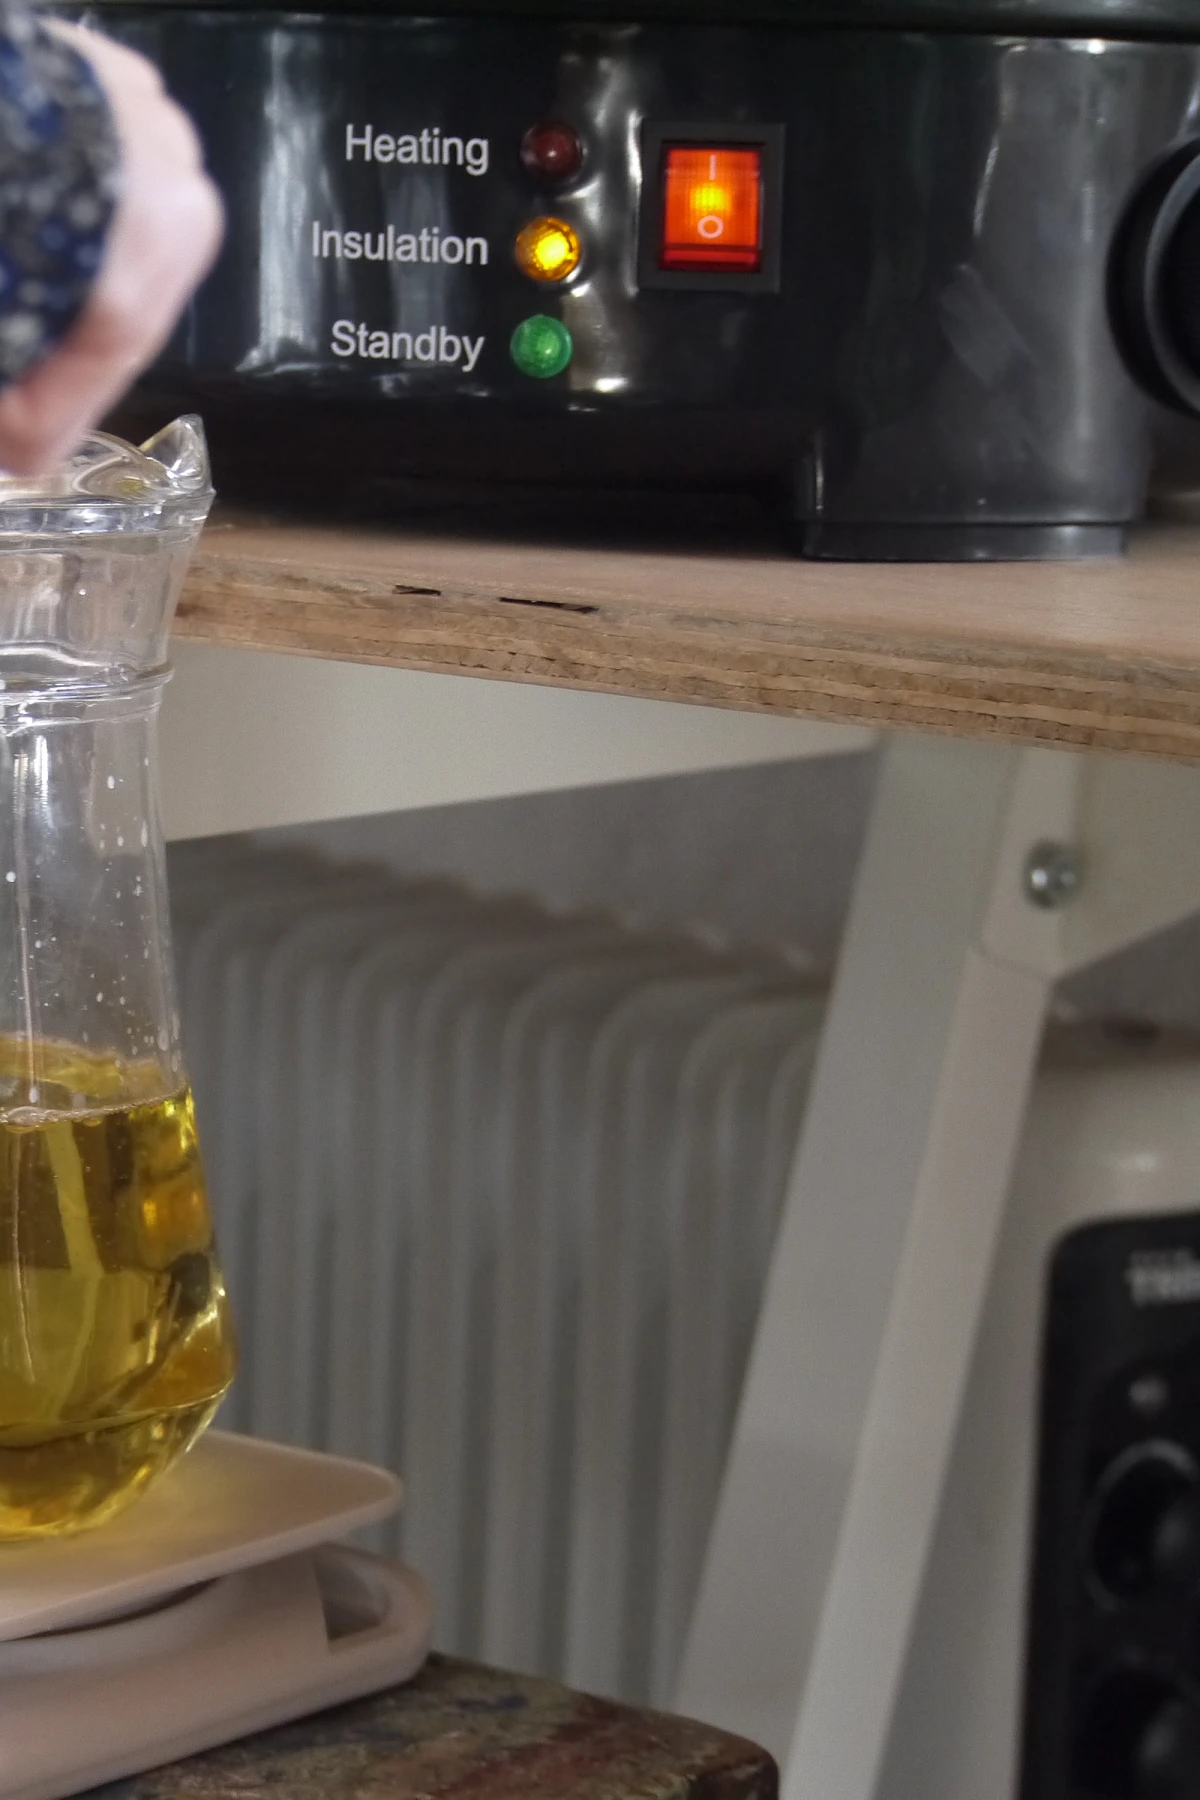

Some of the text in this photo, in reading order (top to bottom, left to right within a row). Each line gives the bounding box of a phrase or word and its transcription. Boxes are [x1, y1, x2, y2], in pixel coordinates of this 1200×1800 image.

[345, 123, 489, 176] Heating
[312, 222, 488, 265] Insulation
[331, 320, 484, 372] Standby
